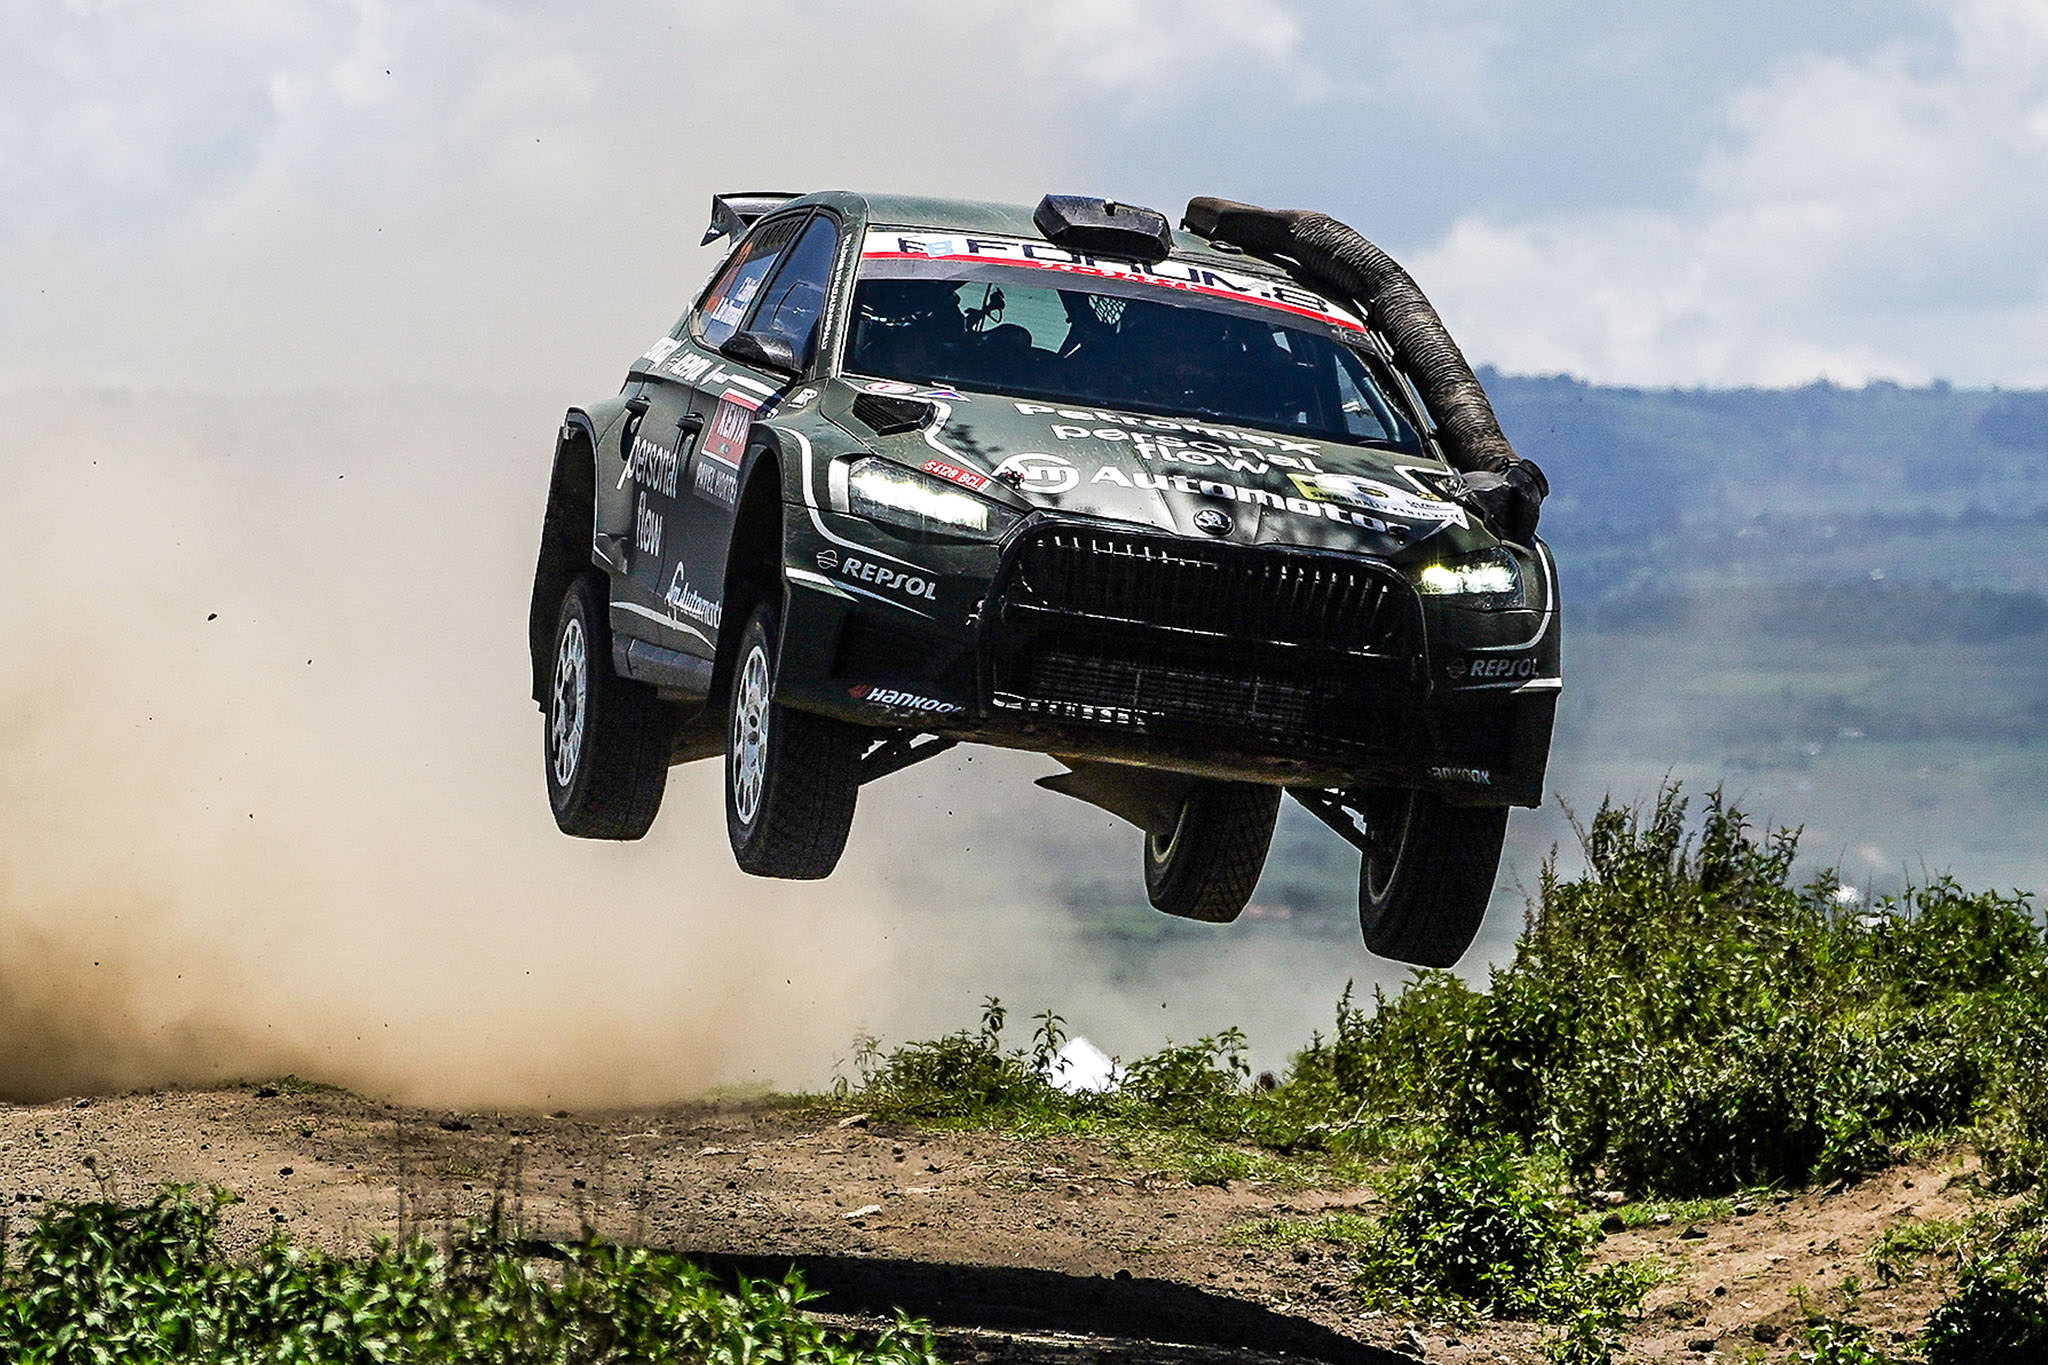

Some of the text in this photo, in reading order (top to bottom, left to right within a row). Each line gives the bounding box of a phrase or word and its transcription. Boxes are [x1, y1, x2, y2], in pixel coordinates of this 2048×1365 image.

[616, 436, 681, 498] personal
[1050, 423, 1323, 473] personal
[1134, 443, 1270, 475] flow
[636, 490, 663, 557] flow
[841, 557, 936, 600] REPSOL
[1470, 658, 1540, 677] REPSOL
